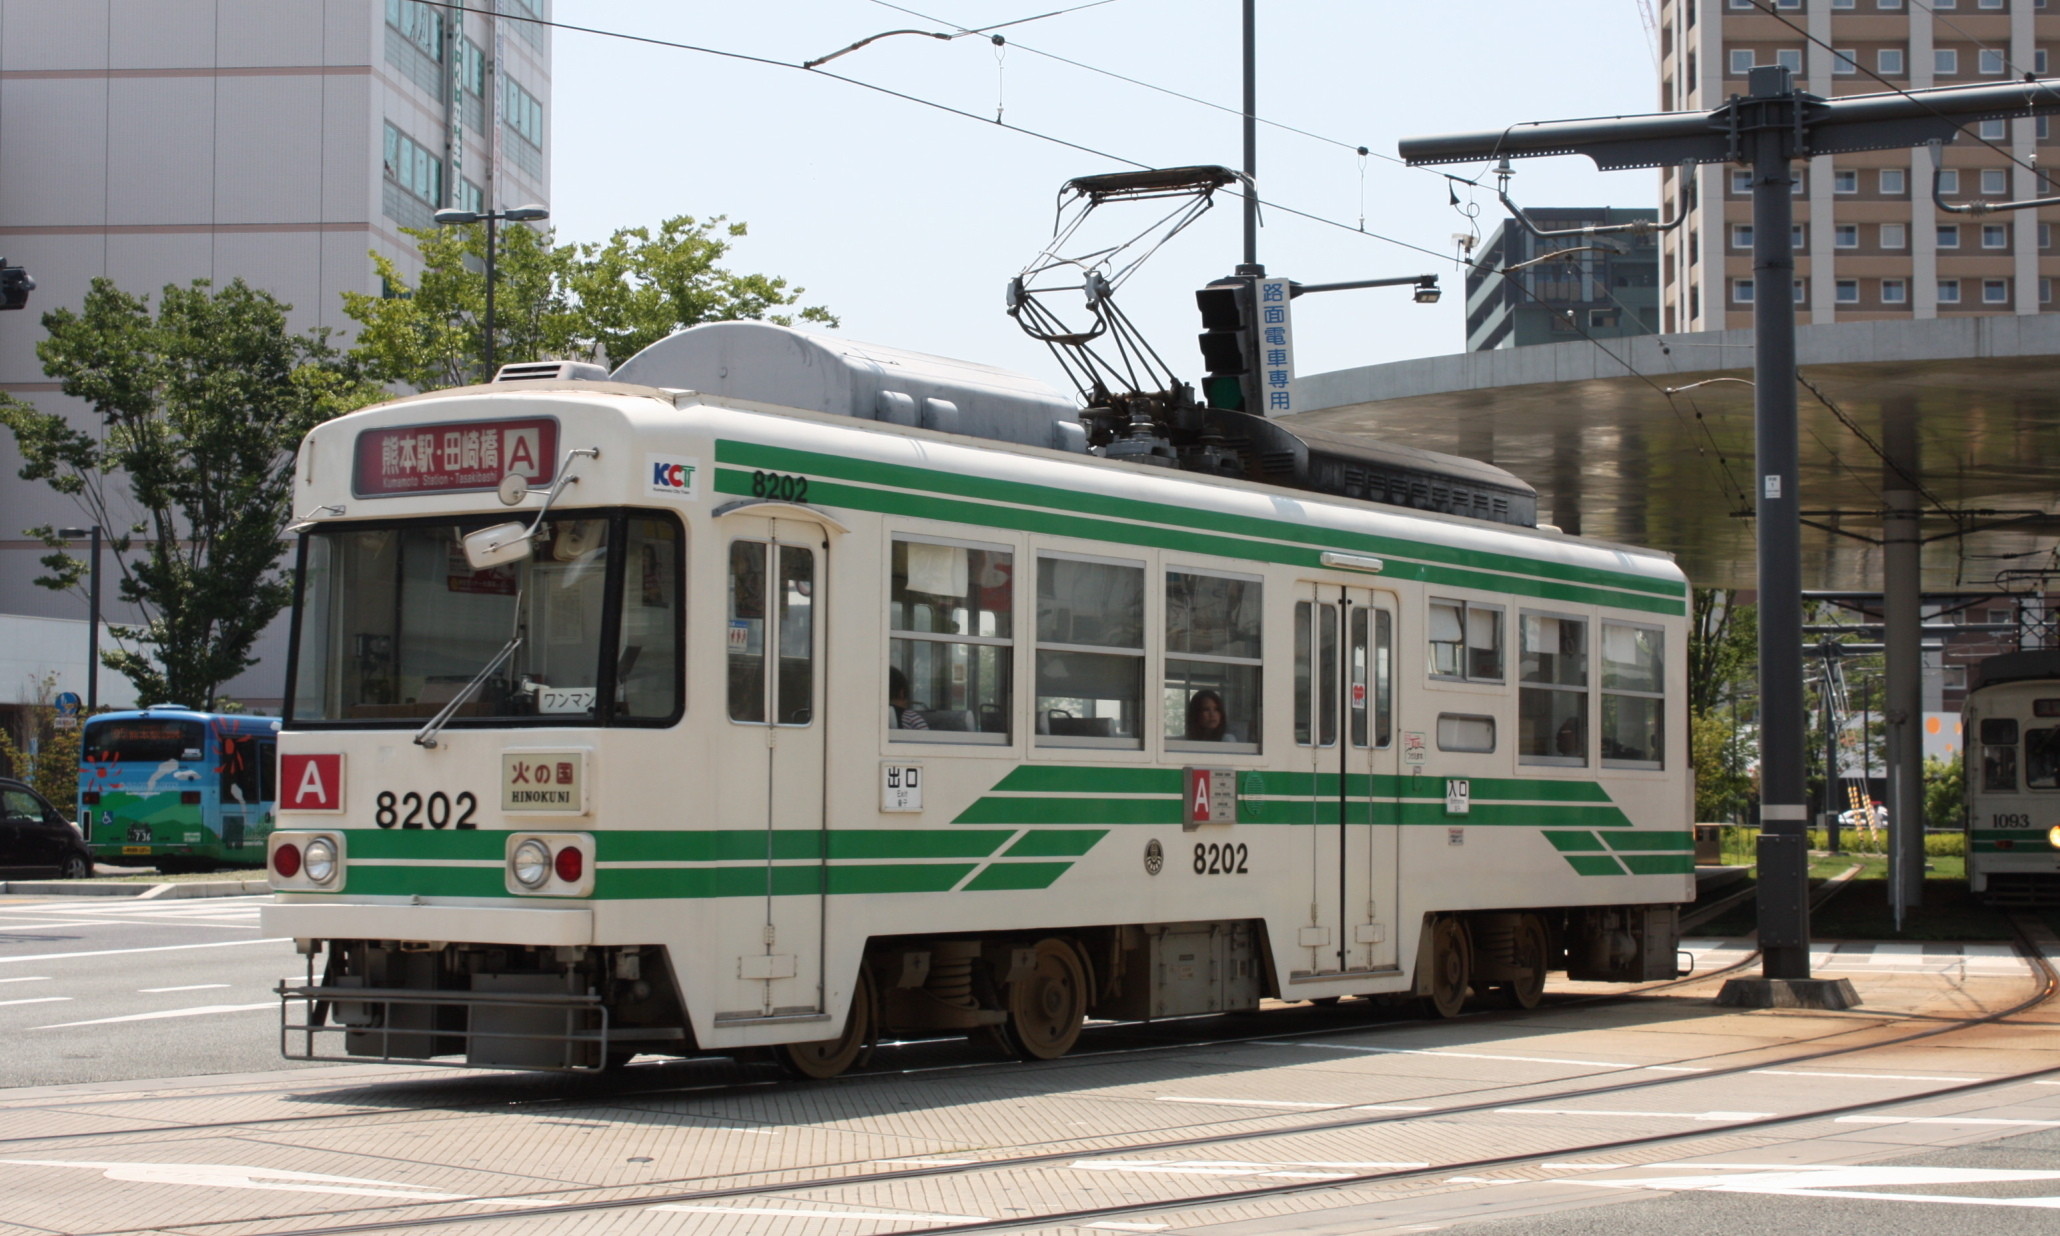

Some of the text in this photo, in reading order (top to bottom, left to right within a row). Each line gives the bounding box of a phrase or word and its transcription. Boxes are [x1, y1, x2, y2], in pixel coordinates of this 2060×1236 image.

[1263, 283, 1290, 410] 路面電車専用
[382, 430, 498, 474] 熊本駅・田崎橋
[508, 435, 535, 472] A
[383, 471, 497, 488] Kumamoto Station Tasakibashi
[653, 462, 696, 488] KCT
[753, 470, 808, 503] 8202
[544, 693, 595, 708] ワンマン
[295, 760, 326, 804] A
[511, 761, 573, 785] 火の国
[888, 766, 918, 788] 出口
[511, 791, 570, 803] HINOKUNI
[1194, 778, 1209, 813] A
[1448, 780, 1467, 797] 入口
[375, 791, 477, 830] 8202
[1992, 814, 2030, 828] 1093
[1193, 842, 1249, 875] 8202
